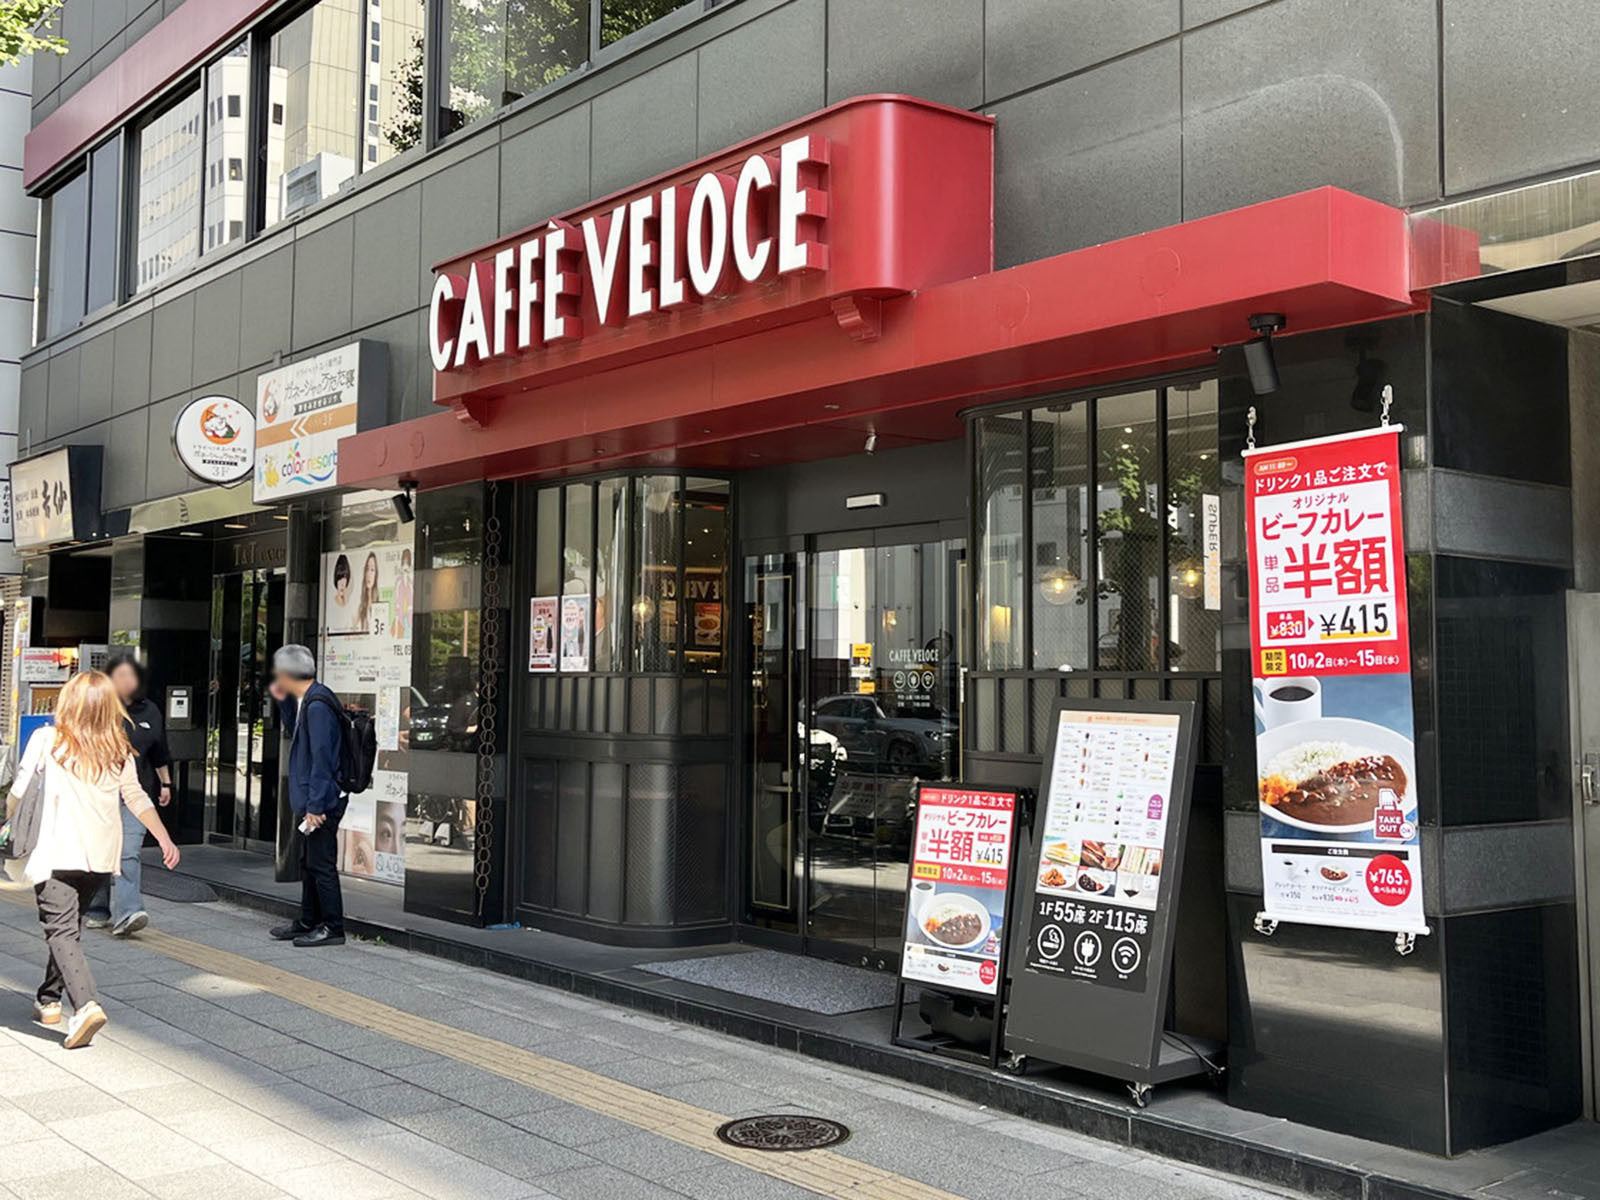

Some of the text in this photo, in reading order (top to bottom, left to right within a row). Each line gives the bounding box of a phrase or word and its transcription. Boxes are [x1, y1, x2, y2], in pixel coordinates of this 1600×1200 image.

[582, 135, 813, 326] VELOCE
[282, 454, 305, 477] color
[1255, 462, 1388, 493] ドリンク1品ご注文で
[1293, 492, 1350, 509] オリジナル
[1261, 508, 1384, 540] ビーフカレー
[1264, 555, 1279, 594] 単品
[1283, 535, 1389, 599] 半額
[373, 618, 385, 636] 3F
[1320, 603, 1389, 636] ¥415
[947, 810, 1007, 830] ビーフカレー
[1378, 815, 1402, 824] TAKE
[1378, 824, 1397, 833] OUT
[928, 828, 974, 863] 半額
[976, 848, 1004, 864] ¥415
